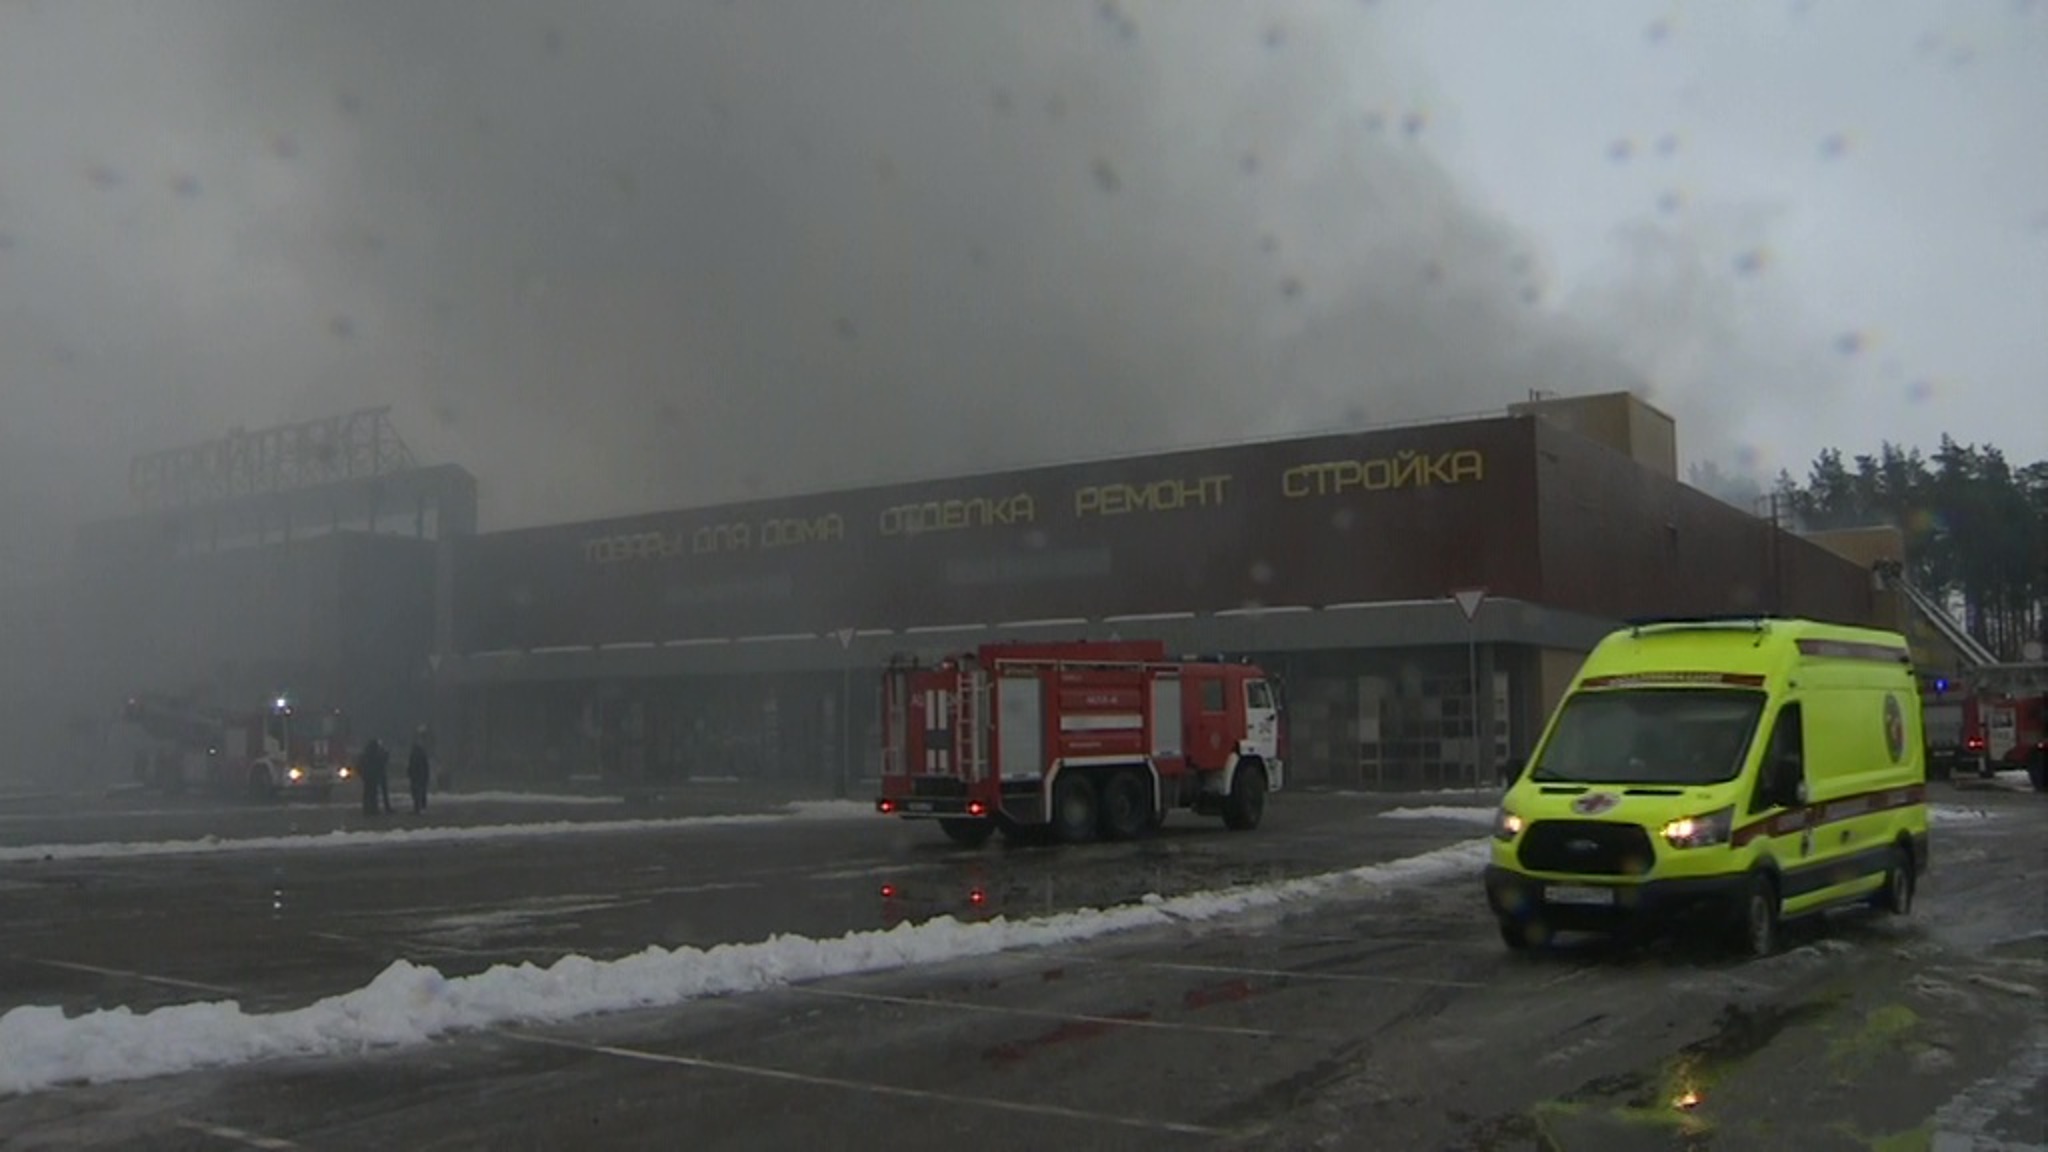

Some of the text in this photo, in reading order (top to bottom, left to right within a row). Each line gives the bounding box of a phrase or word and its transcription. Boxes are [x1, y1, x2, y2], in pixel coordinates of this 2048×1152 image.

[1075, 473, 1232, 517] РЕМОНТ
[1282, 449, 1484, 499] СТРОЙКА
[880, 492, 1035, 537] ОТДЕЛКА
[586, 514, 844, 562] ТОВАРЫ ДЛЯ ДОМА
